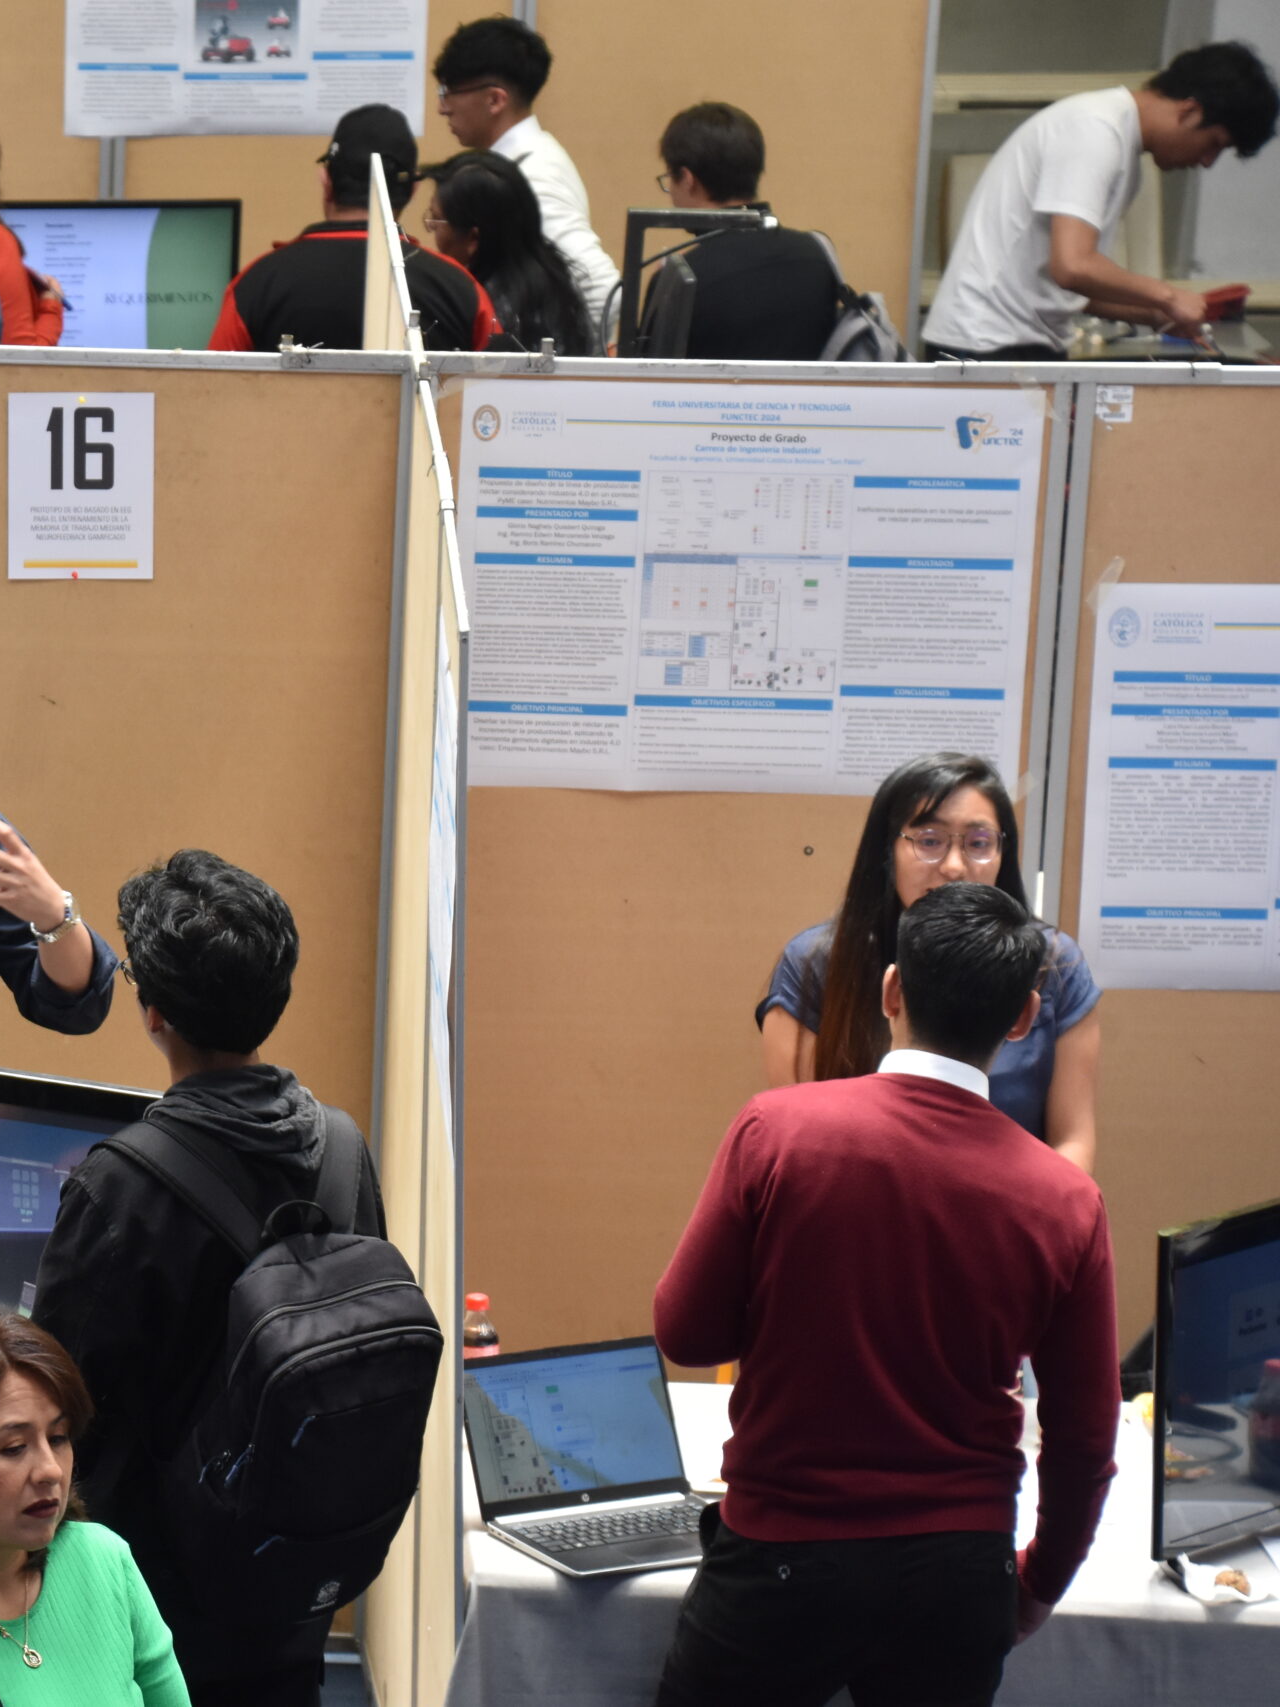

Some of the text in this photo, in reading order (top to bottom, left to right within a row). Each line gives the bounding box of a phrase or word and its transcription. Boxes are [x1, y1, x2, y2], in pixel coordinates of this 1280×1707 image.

[653, 400, 675, 408] FERIA
[678, 401, 740, 410] UNIVERSITARIA
[742, 402, 753, 410] DE
[755, 402, 788, 411] CIENCIA
[799, 402, 851, 412] TECNOLOGÍA
[721, 413, 780, 422] FUNCTEC 2024
[711, 432, 806, 444] Proyecto de Grado
[46, 406, 114, 490] 16
[695, 444, 725, 453] Carrera
[727, 445, 736, 453] de
